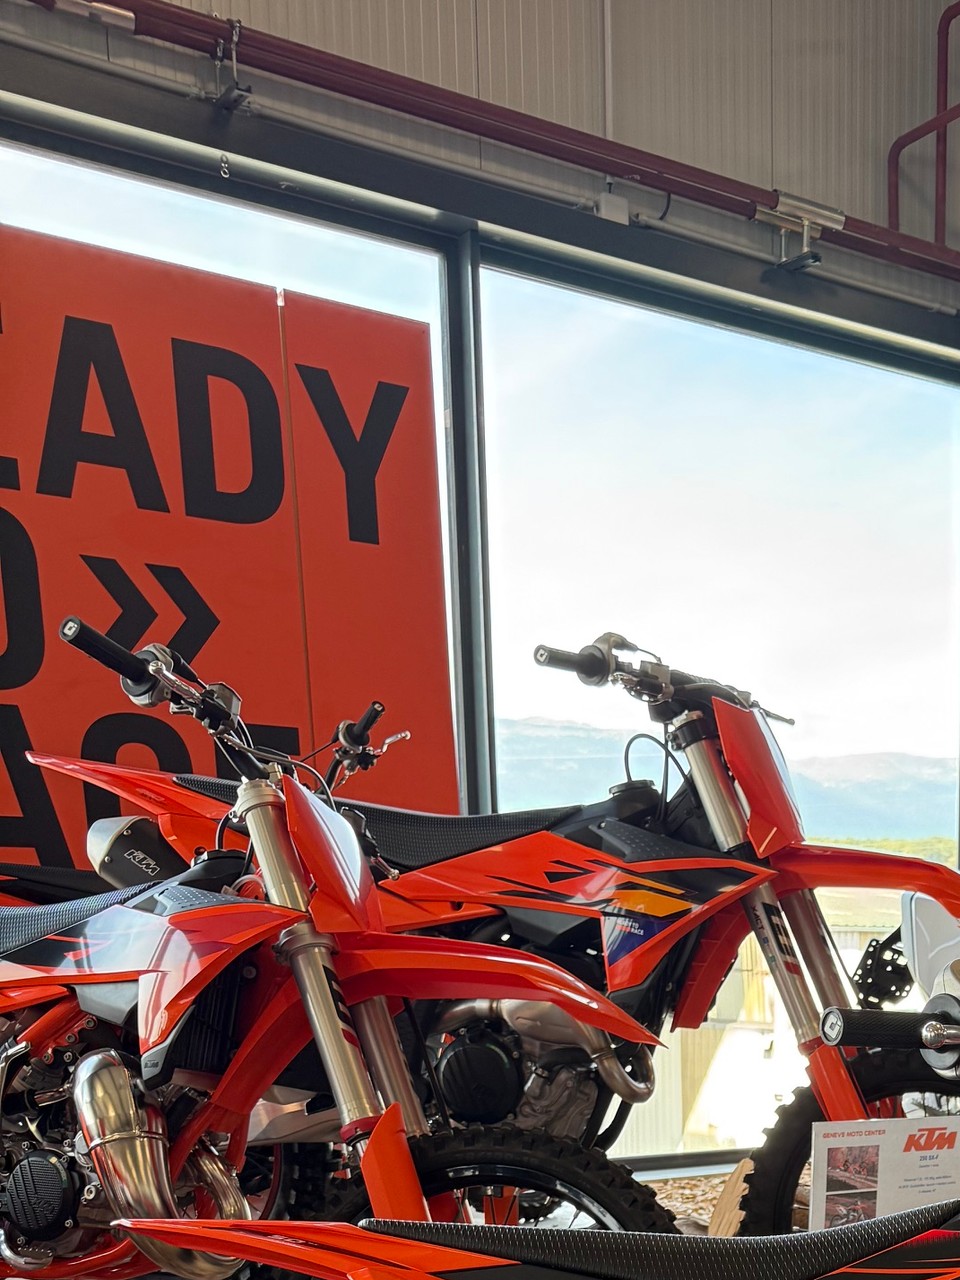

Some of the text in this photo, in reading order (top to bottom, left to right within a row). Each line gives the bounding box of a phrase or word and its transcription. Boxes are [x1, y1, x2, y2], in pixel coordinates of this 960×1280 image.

[0, 301, 409, 545] ADY
[124, 849, 160, 876] KTM
[864, 1129, 886, 1137] CENTER
[903, 1127, 957, 1152] KTM
